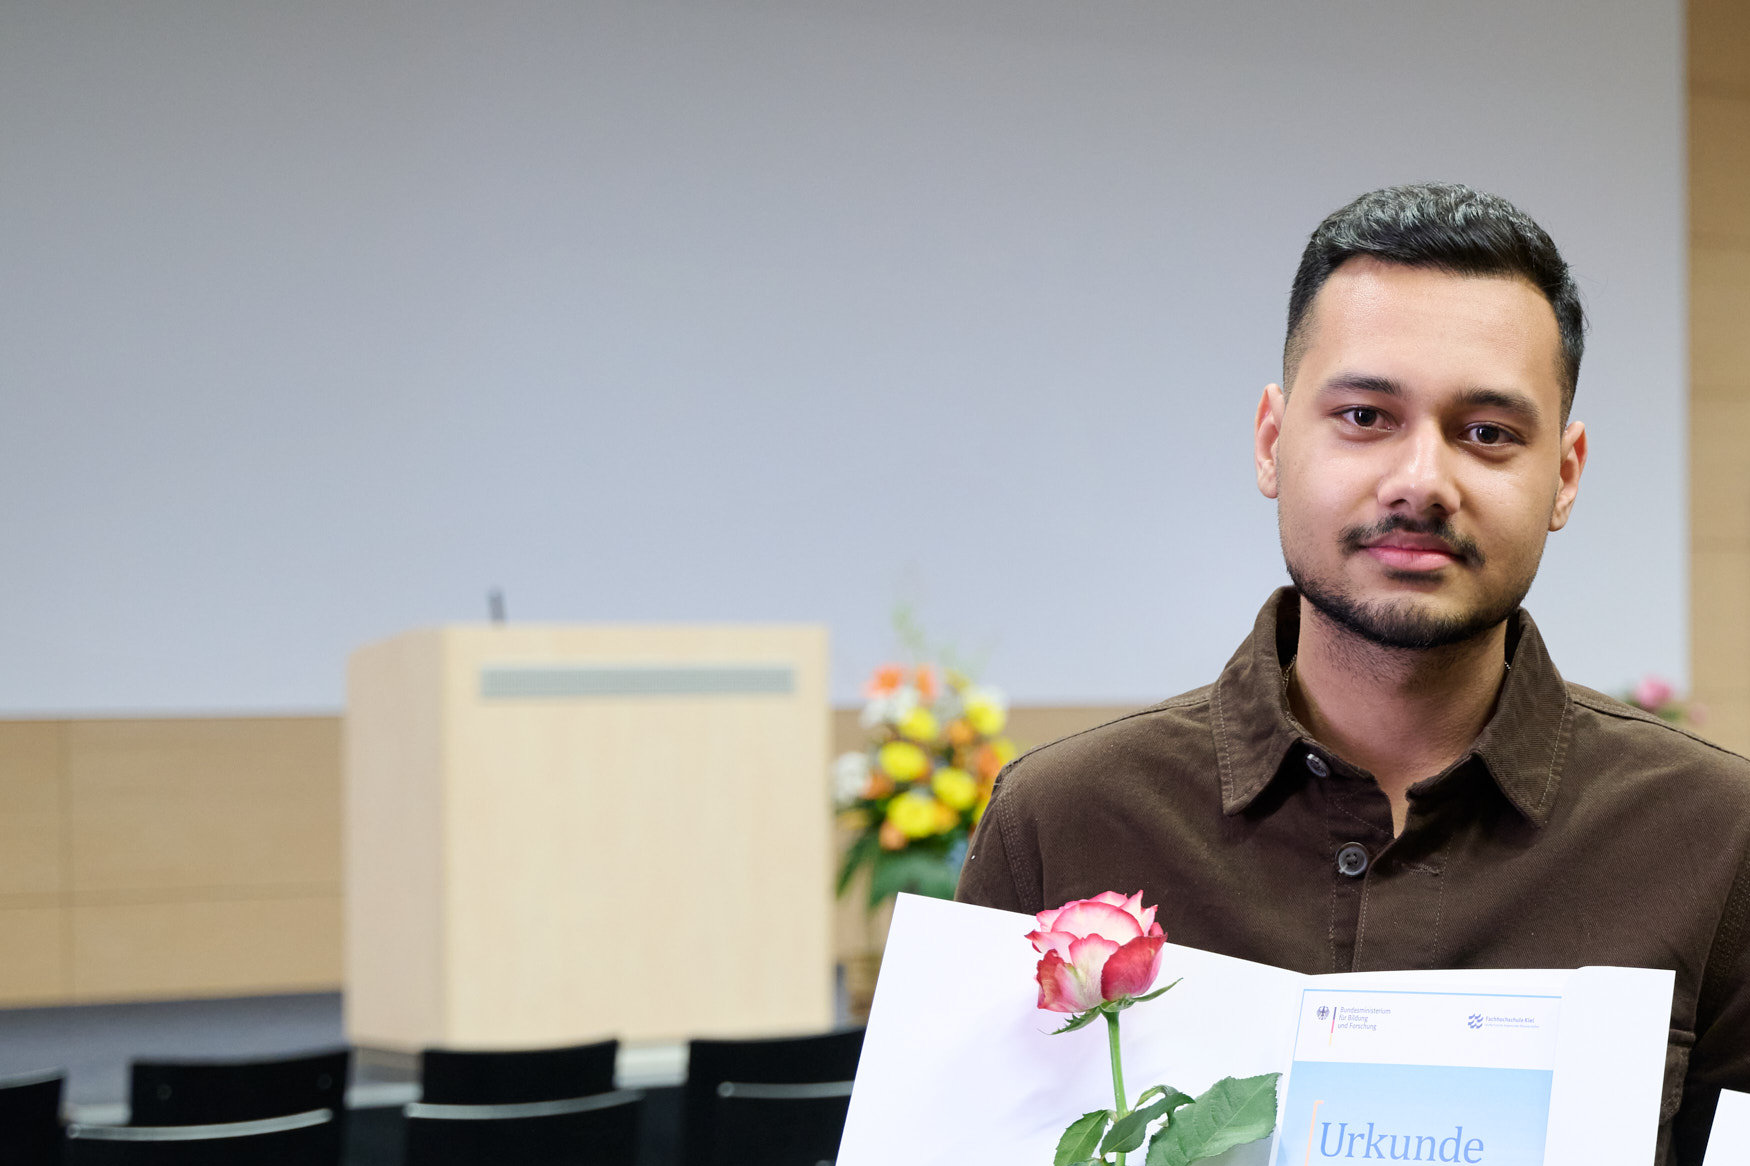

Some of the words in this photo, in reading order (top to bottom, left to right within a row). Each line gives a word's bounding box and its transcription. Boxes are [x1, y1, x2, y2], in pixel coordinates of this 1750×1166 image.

[1340, 1006, 1391, 1015] Bundesministerium
[1339, 1014, 1347, 1022] für
[1347, 1015, 1368, 1023] Bildung
[1485, 1015, 1523, 1024] Fachhochschule
[1349, 1022, 1377, 1031] Forschung
[1320, 1122, 1484, 1164] Urkunde
